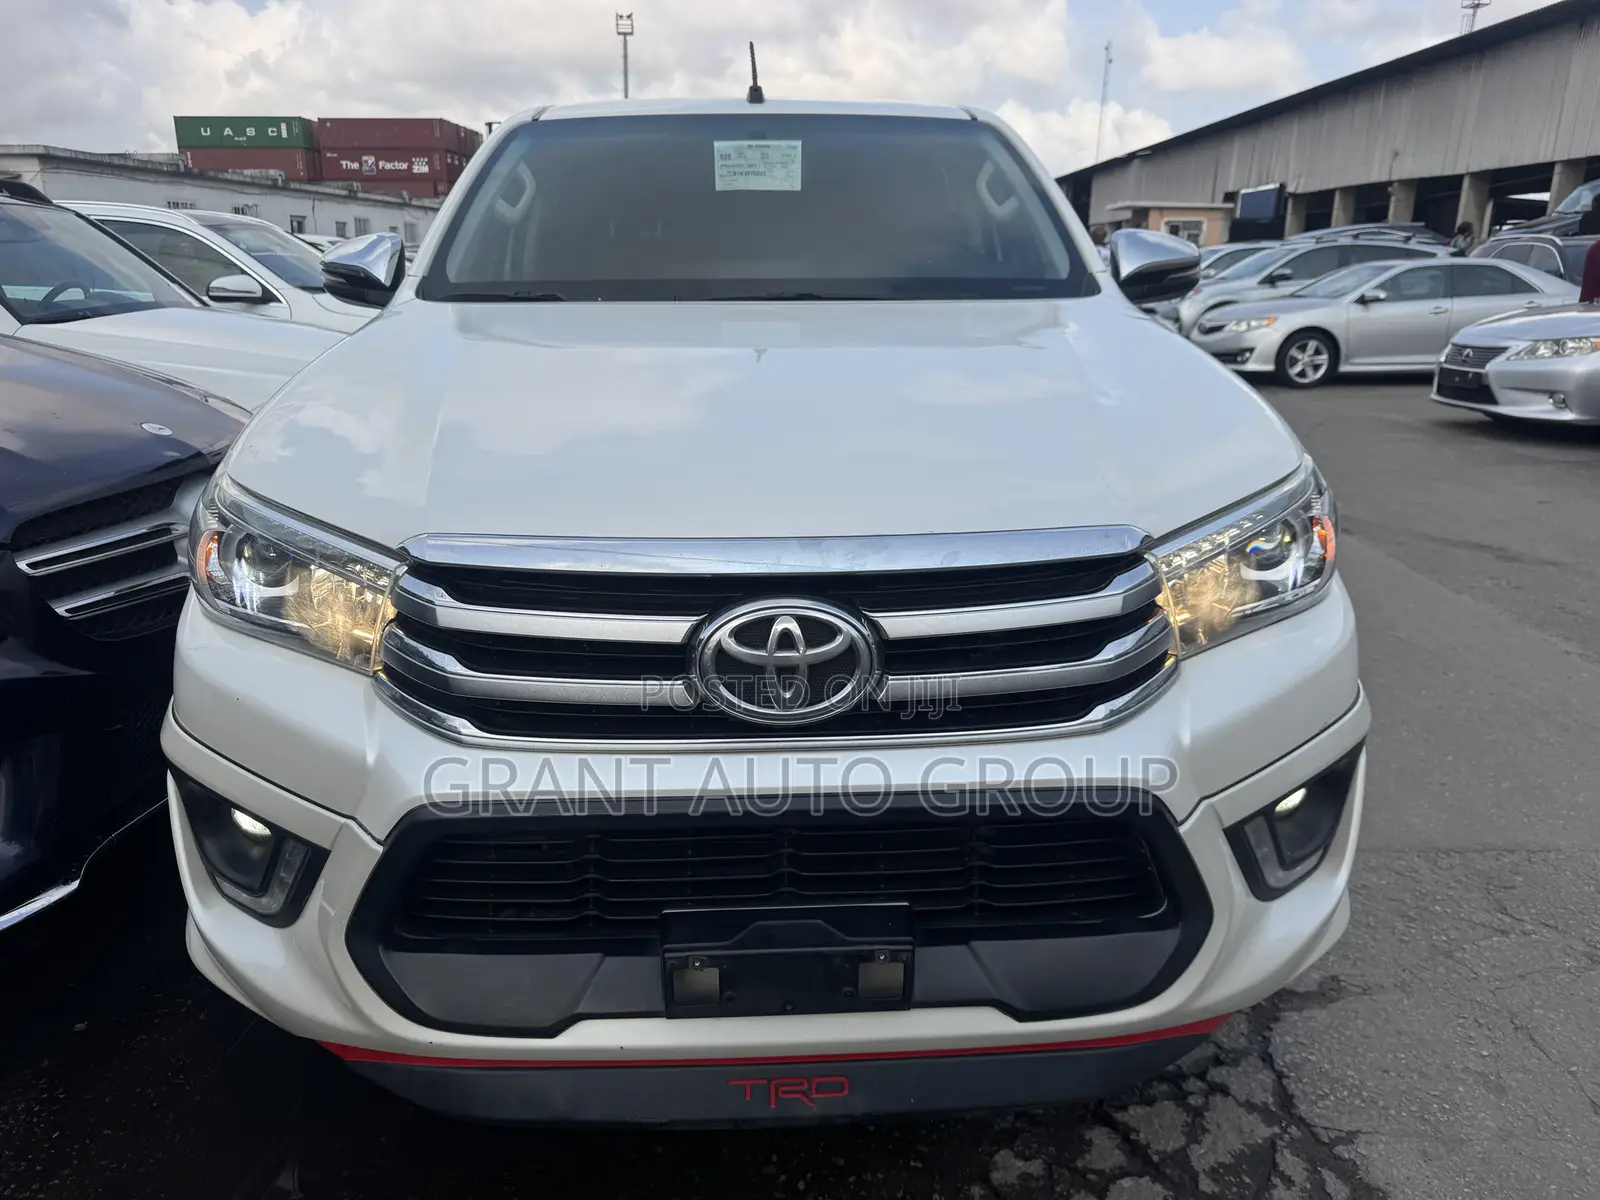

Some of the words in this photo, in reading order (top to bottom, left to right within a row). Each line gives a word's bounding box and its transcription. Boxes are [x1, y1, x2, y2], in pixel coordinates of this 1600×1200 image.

[340, 160, 360, 170] The
[379, 160, 409, 170] Factor
[726, 1075, 850, 1109] TRD
